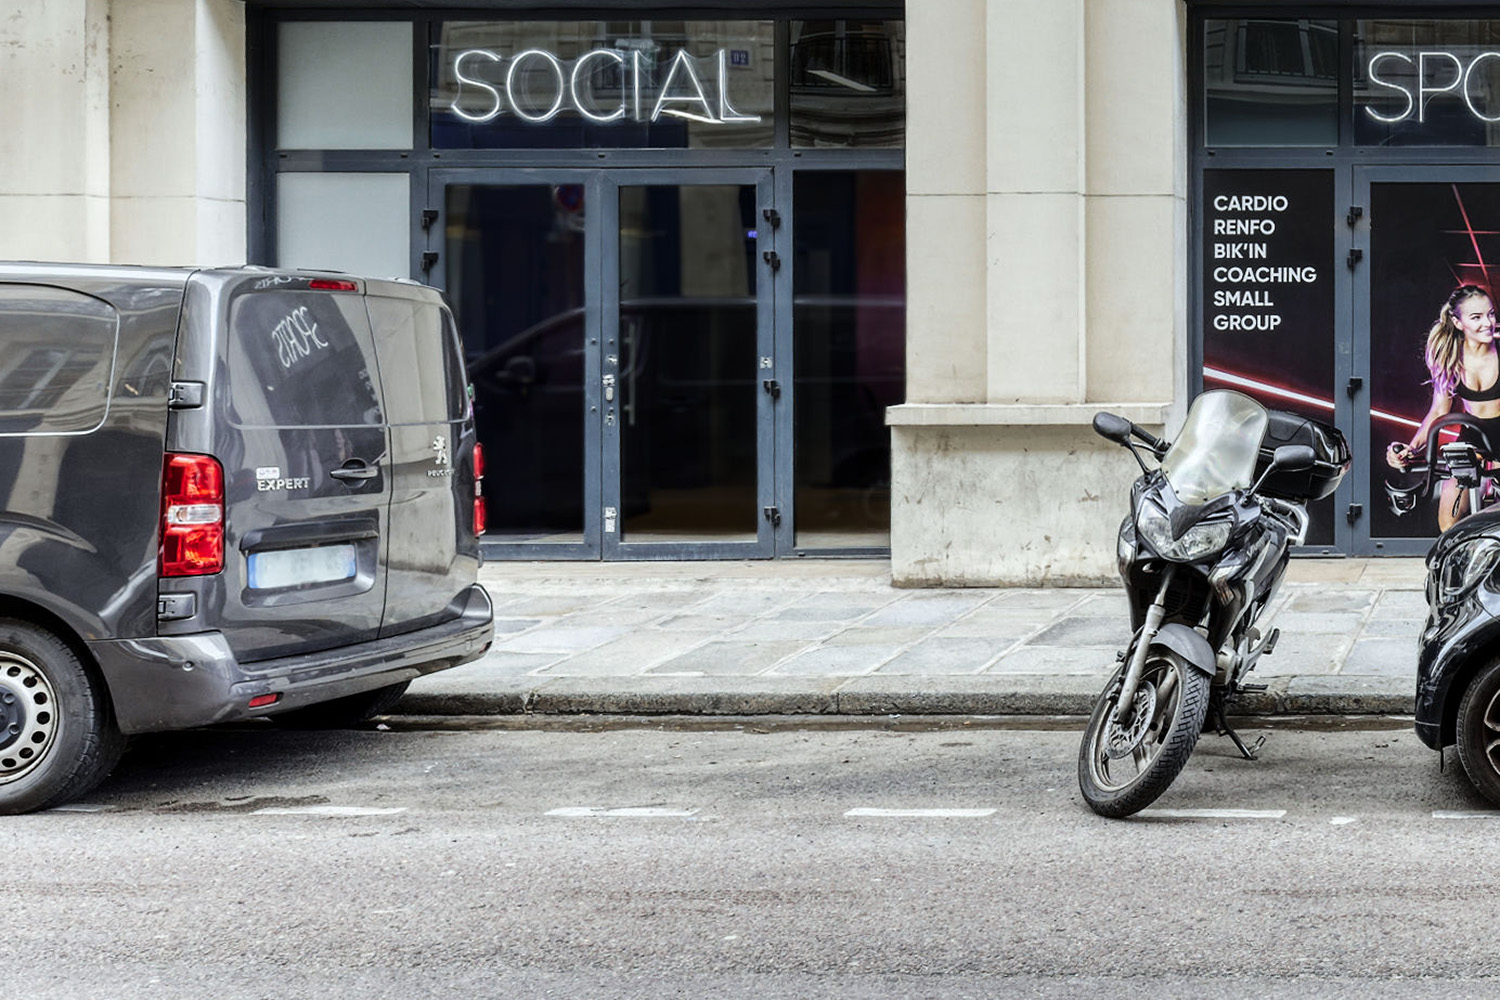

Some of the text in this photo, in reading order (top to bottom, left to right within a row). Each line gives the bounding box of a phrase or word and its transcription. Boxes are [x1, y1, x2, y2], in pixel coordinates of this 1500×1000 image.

[451, 49, 761, 123] SOCIAL
[1214, 195, 1288, 211] CARDIO
[1214, 219, 1275, 235] RENFO
[1214, 243, 1267, 259] BIK'IN
[1214, 267, 1316, 283] COACHING
[1214, 291, 1273, 307] SMALL
[1214, 315, 1281, 331] GROUP
[257, 476, 310, 491] EXPERT
